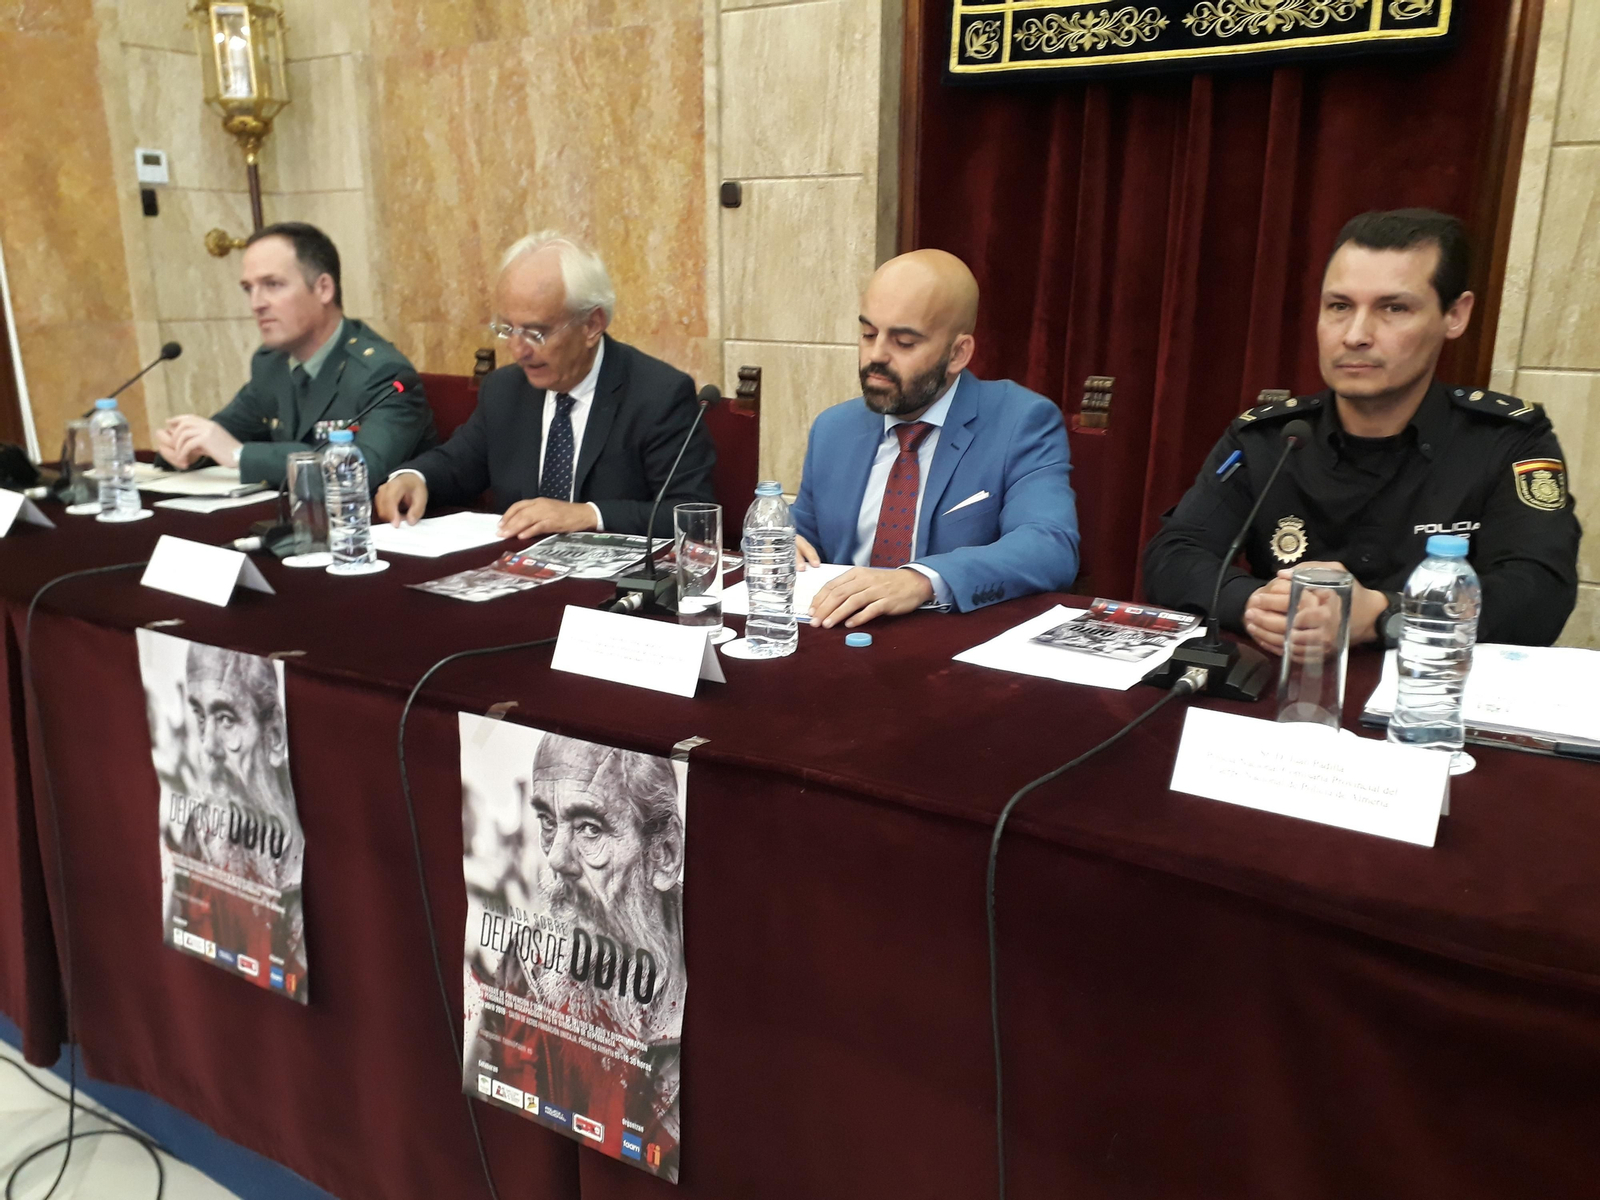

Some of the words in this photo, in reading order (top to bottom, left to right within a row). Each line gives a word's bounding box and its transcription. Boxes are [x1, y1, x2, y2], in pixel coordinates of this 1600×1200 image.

[480, 911, 542, 965] DELITOS
[544, 933, 567, 975] DE
[571, 927, 656, 1004] ODIO
